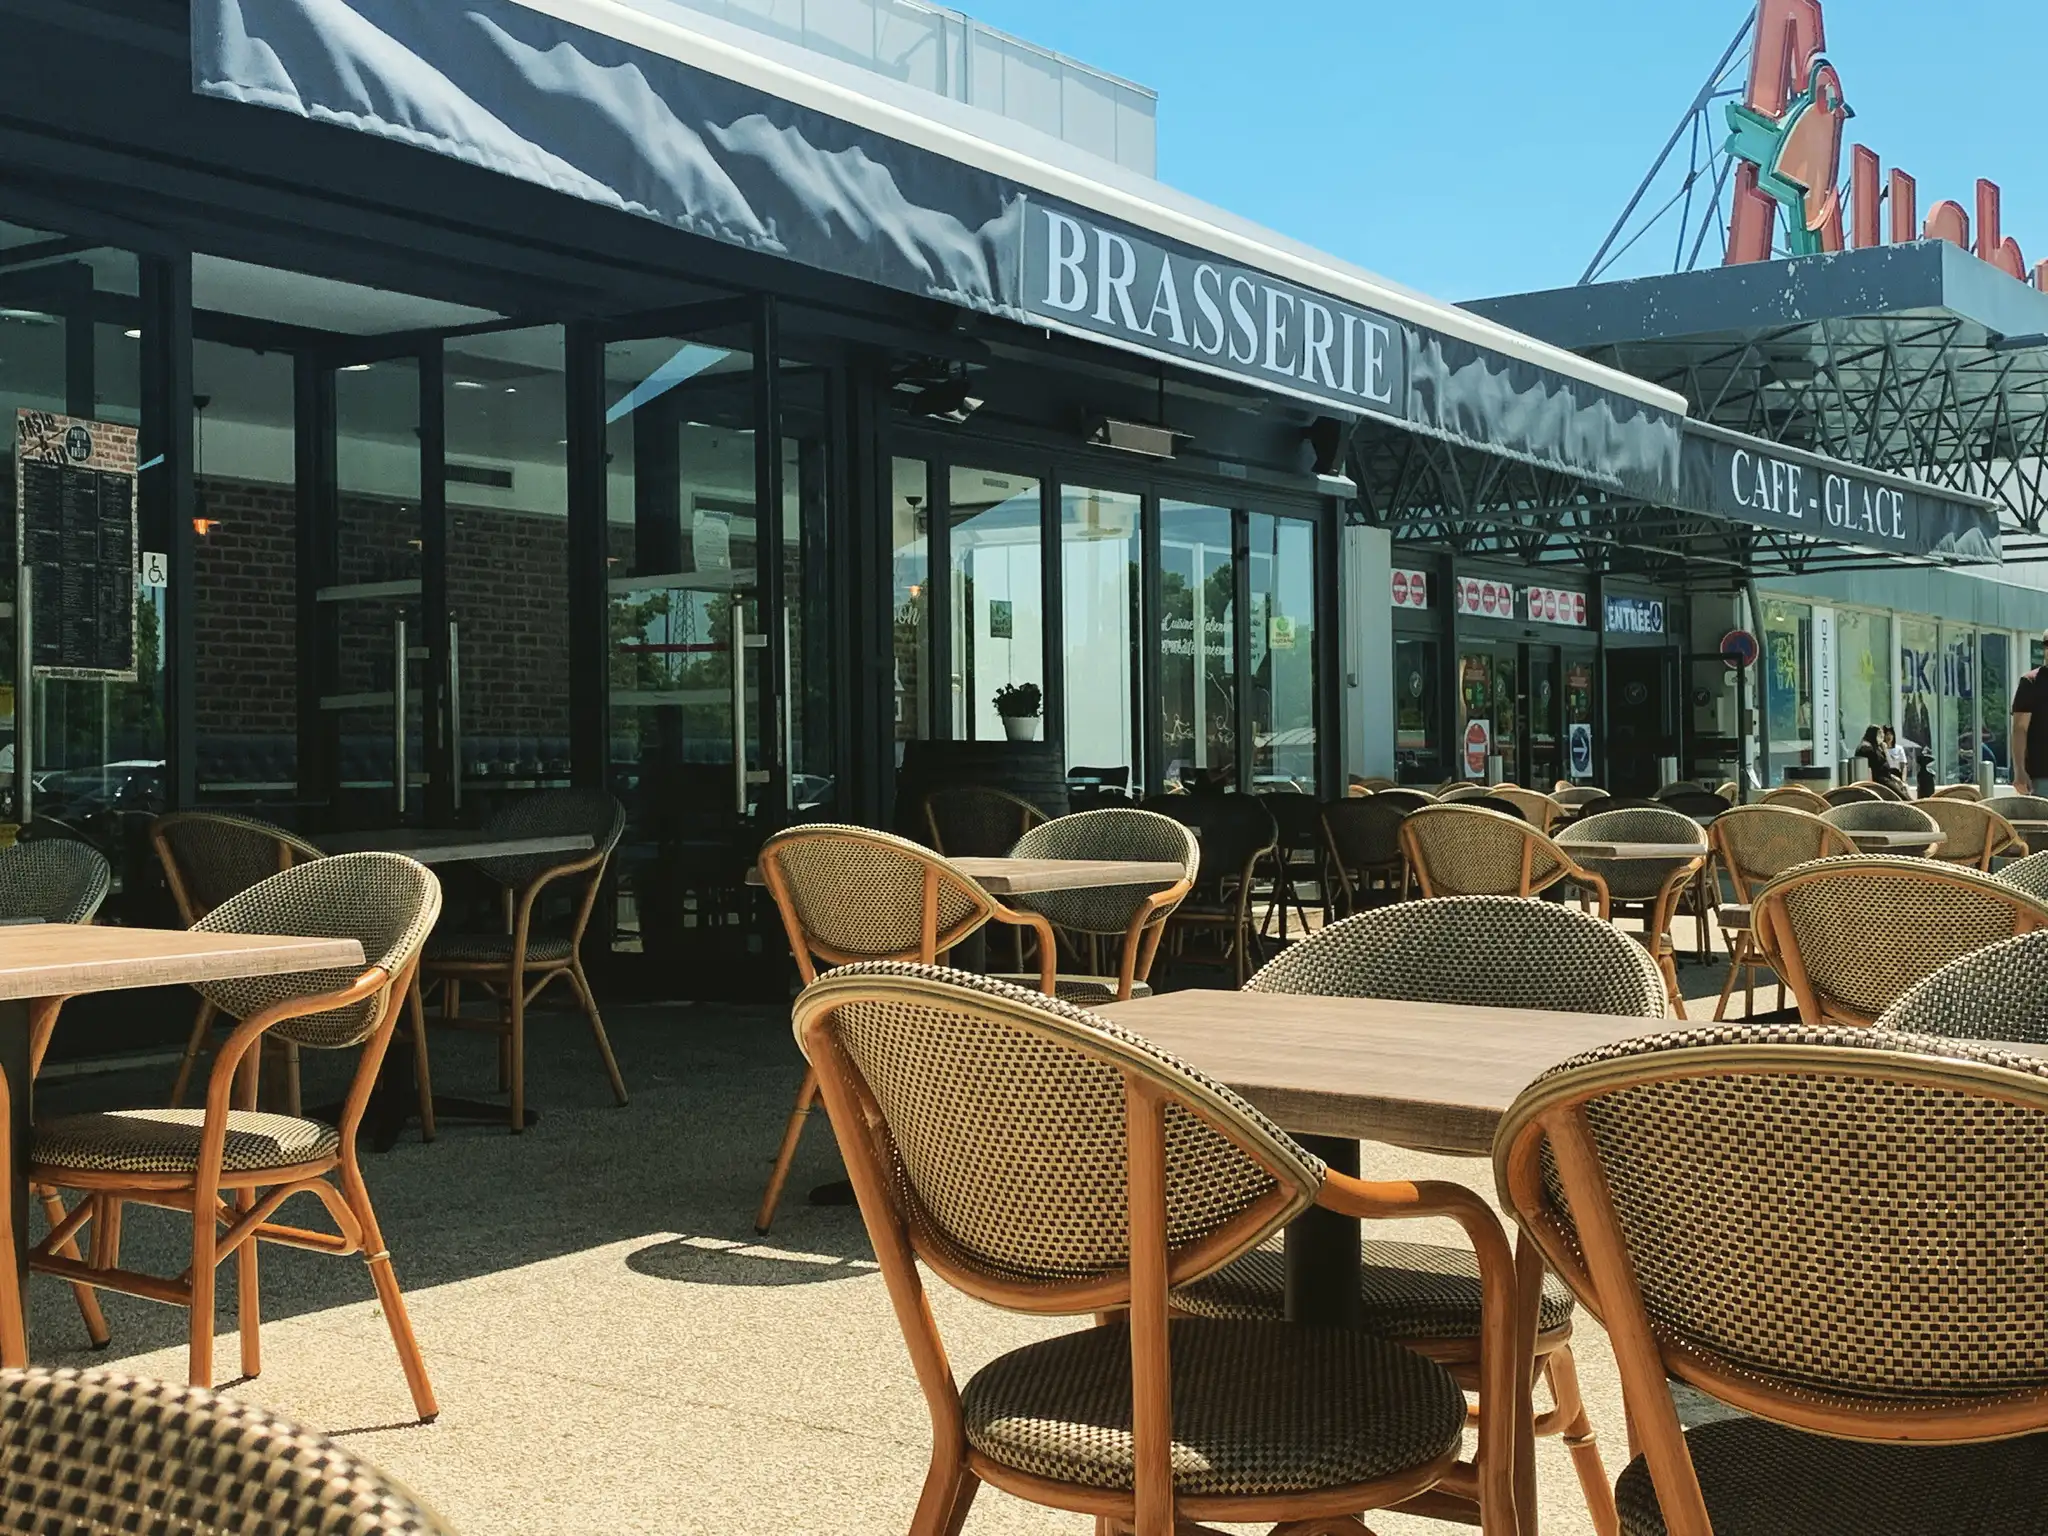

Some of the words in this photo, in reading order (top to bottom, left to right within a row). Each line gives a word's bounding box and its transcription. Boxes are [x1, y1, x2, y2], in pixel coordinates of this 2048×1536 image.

[1042, 209, 1392, 405] BRASSERIE
[1731, 449, 1803, 519] CAFE
[1825, 474, 1906, 540] GLACE
[1608, 602, 1651, 631] ENTRÉE
